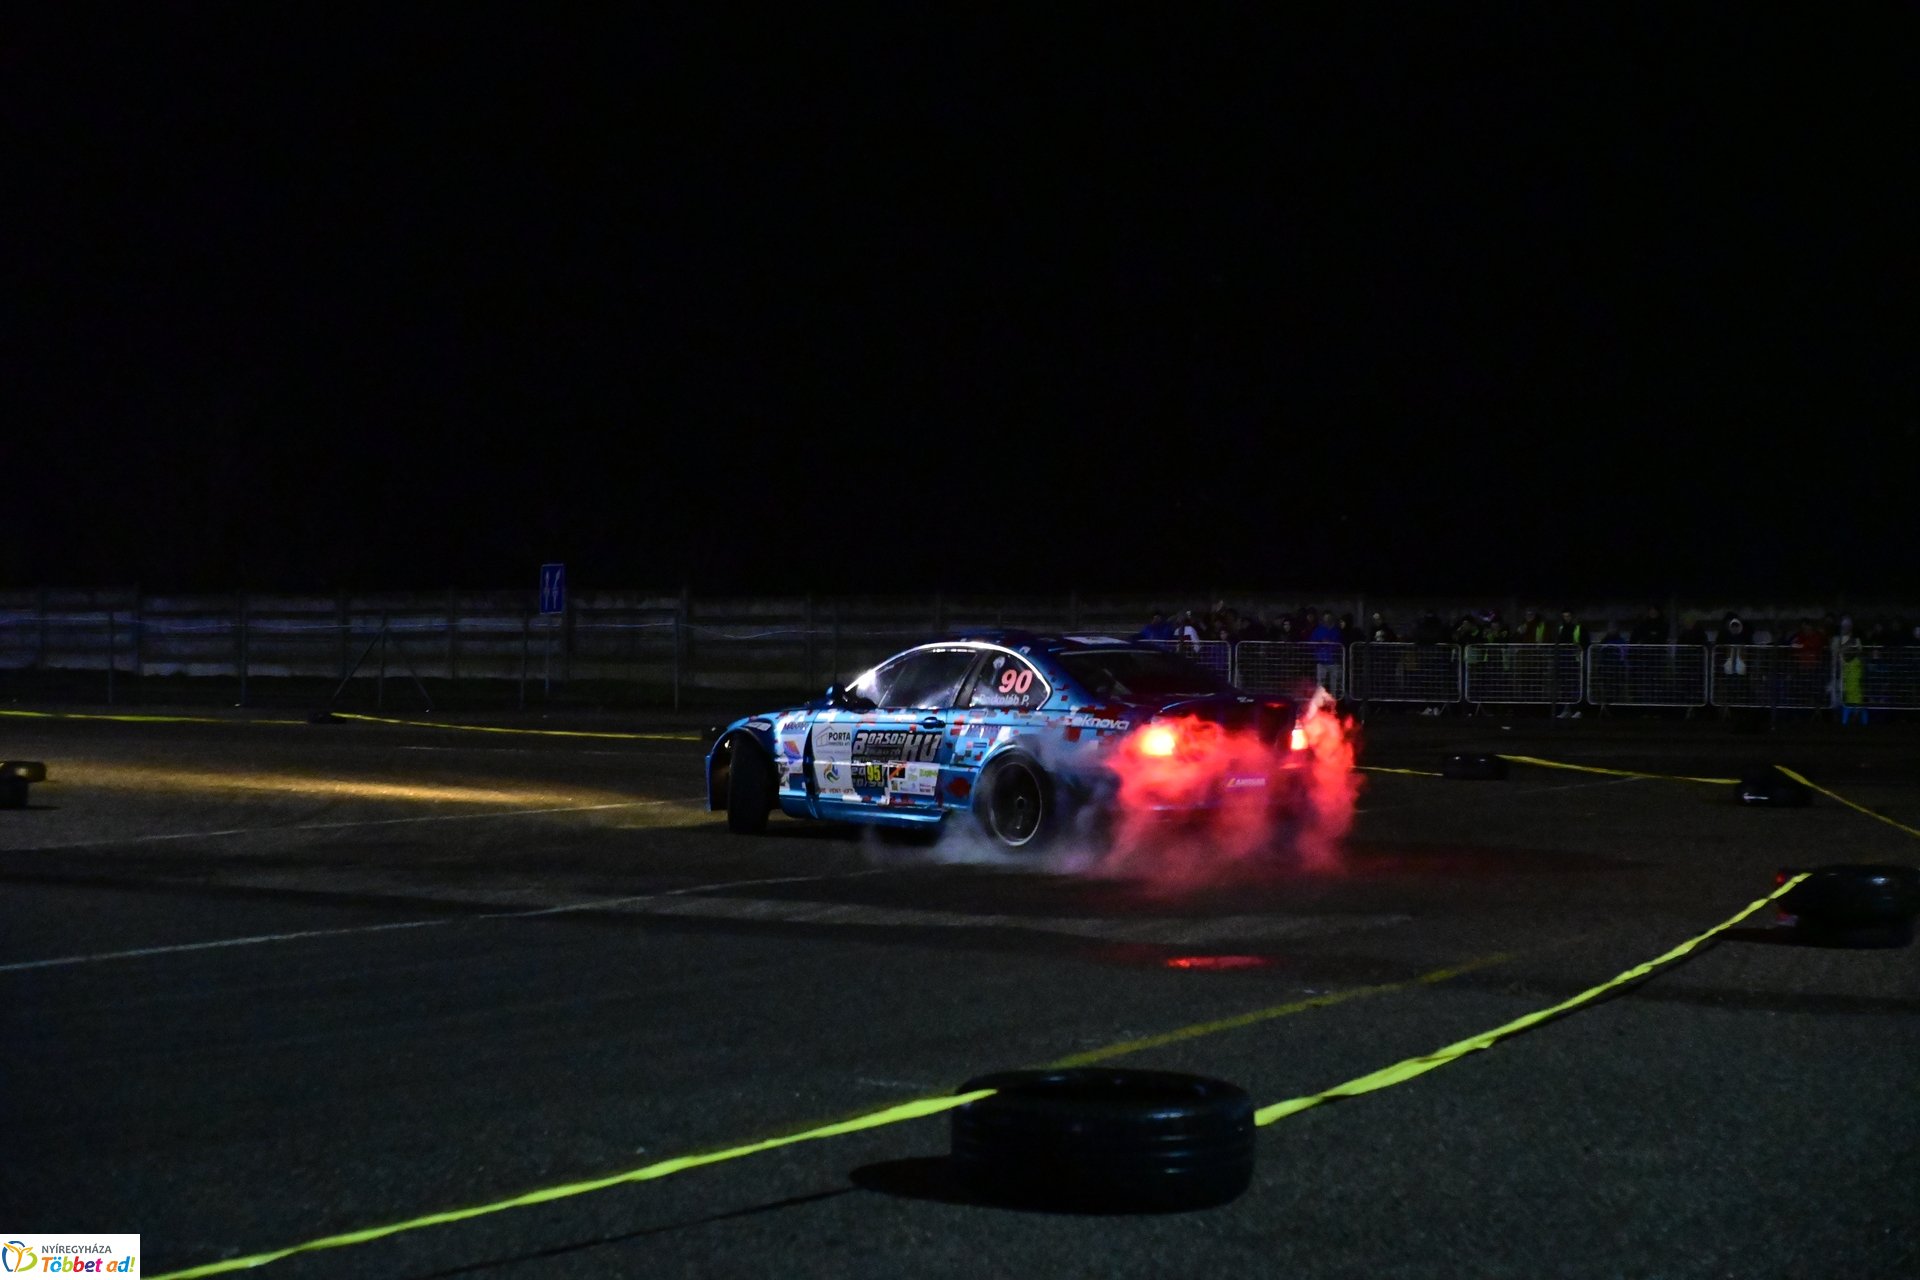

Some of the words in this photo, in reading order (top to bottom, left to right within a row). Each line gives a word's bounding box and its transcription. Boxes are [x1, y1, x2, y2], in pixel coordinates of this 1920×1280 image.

[998, 669, 1033, 694] 90
[828, 732, 851, 741] PORTA
[867, 765, 881, 782] 95
